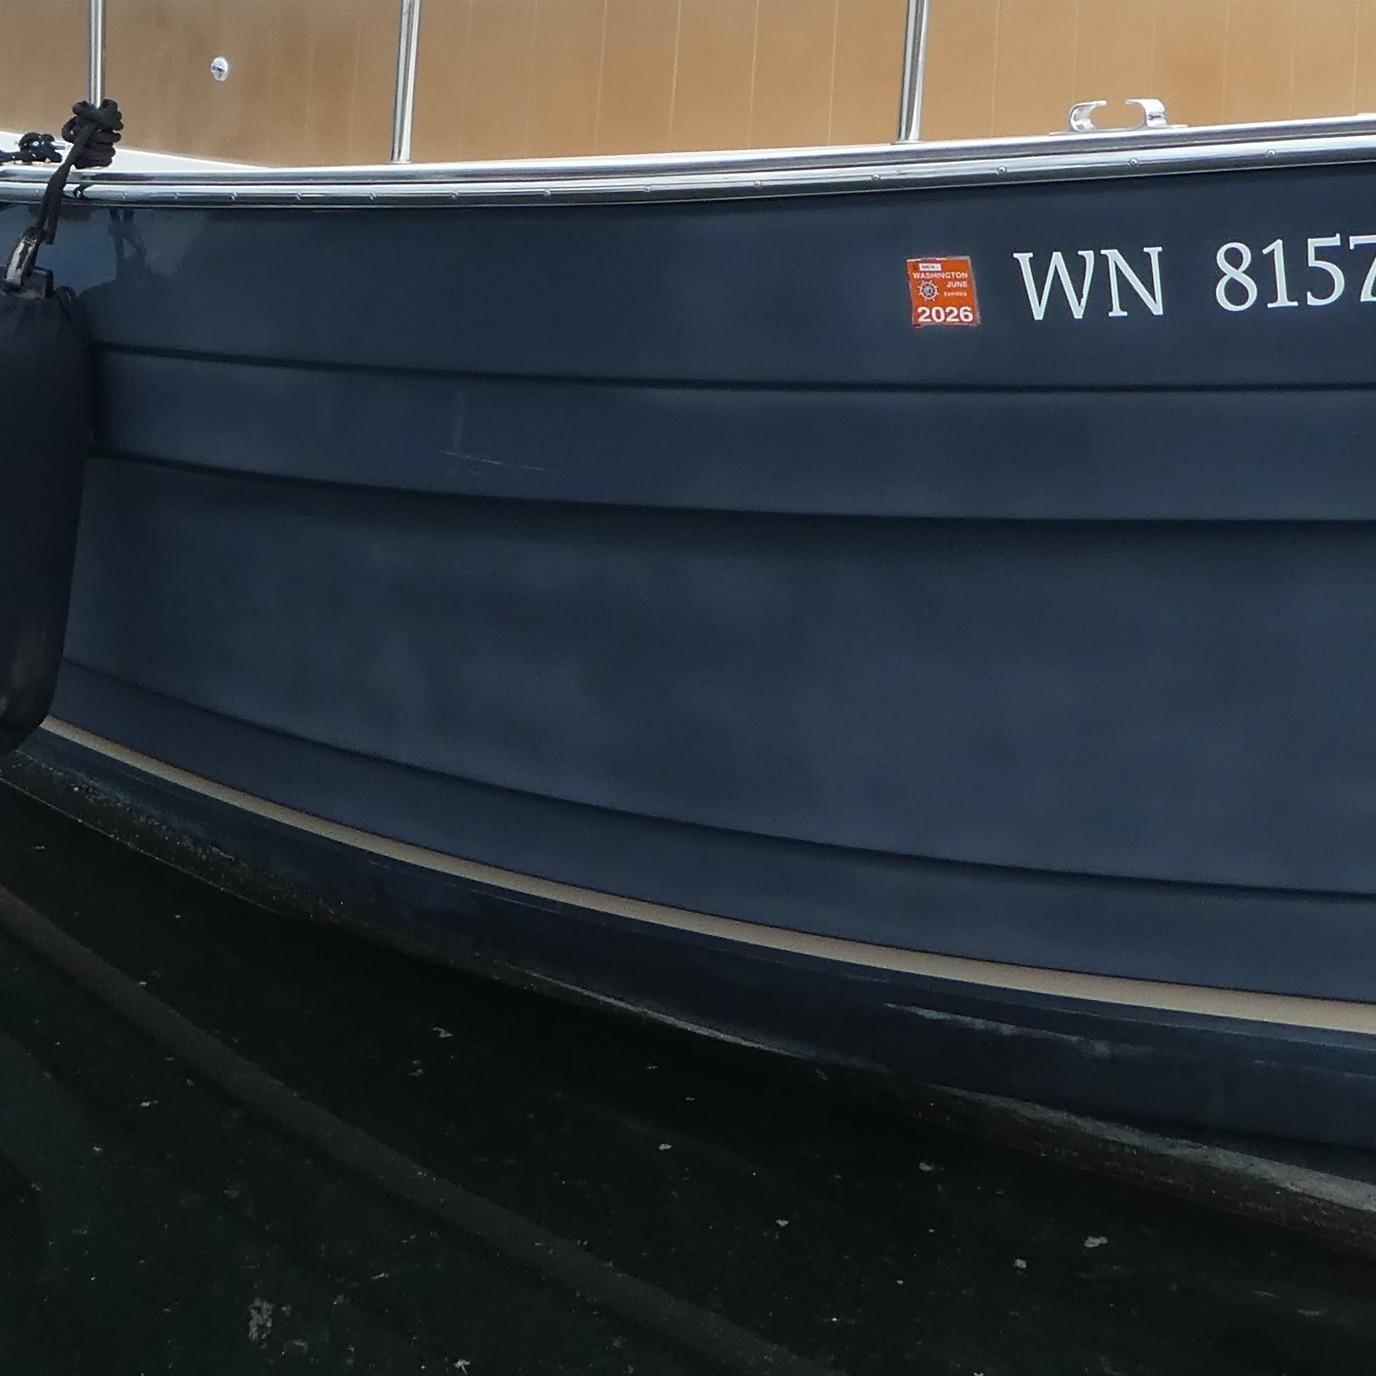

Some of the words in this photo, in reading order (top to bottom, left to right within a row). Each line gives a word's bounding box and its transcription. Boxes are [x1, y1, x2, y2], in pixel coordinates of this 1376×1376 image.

[912, 271, 968, 279] WASHINGTON
[1012, 246, 1164, 321] WN
[917, 306, 974, 322] 2026
